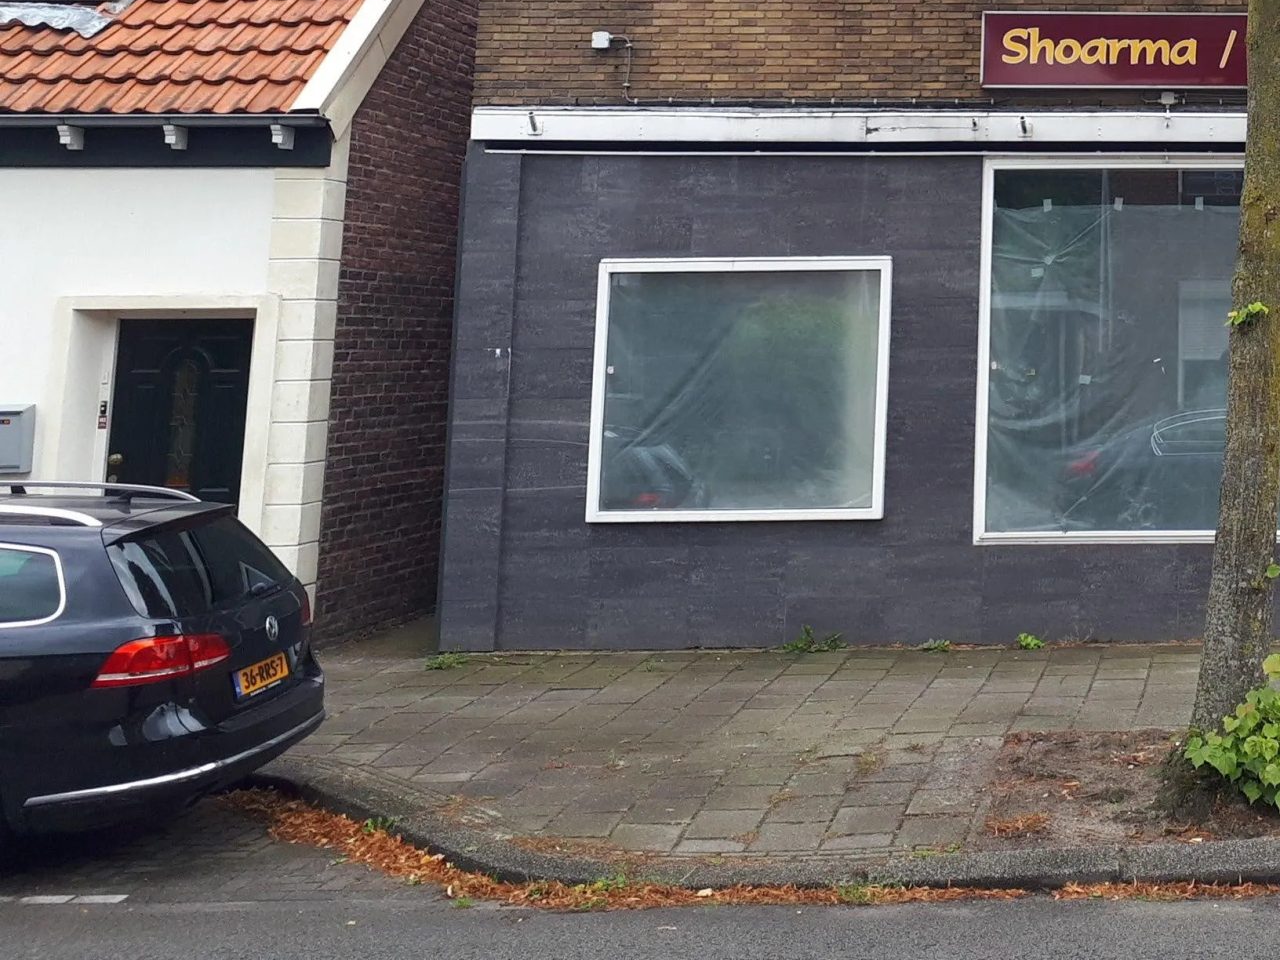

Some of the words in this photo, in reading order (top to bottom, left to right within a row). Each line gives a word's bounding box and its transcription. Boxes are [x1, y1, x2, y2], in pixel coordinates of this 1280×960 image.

[1001, 27, 1198, 67] Shoarma
[1219, 29, 1237, 69] /
[242, 656, 284, 690] 36-RRS-7
